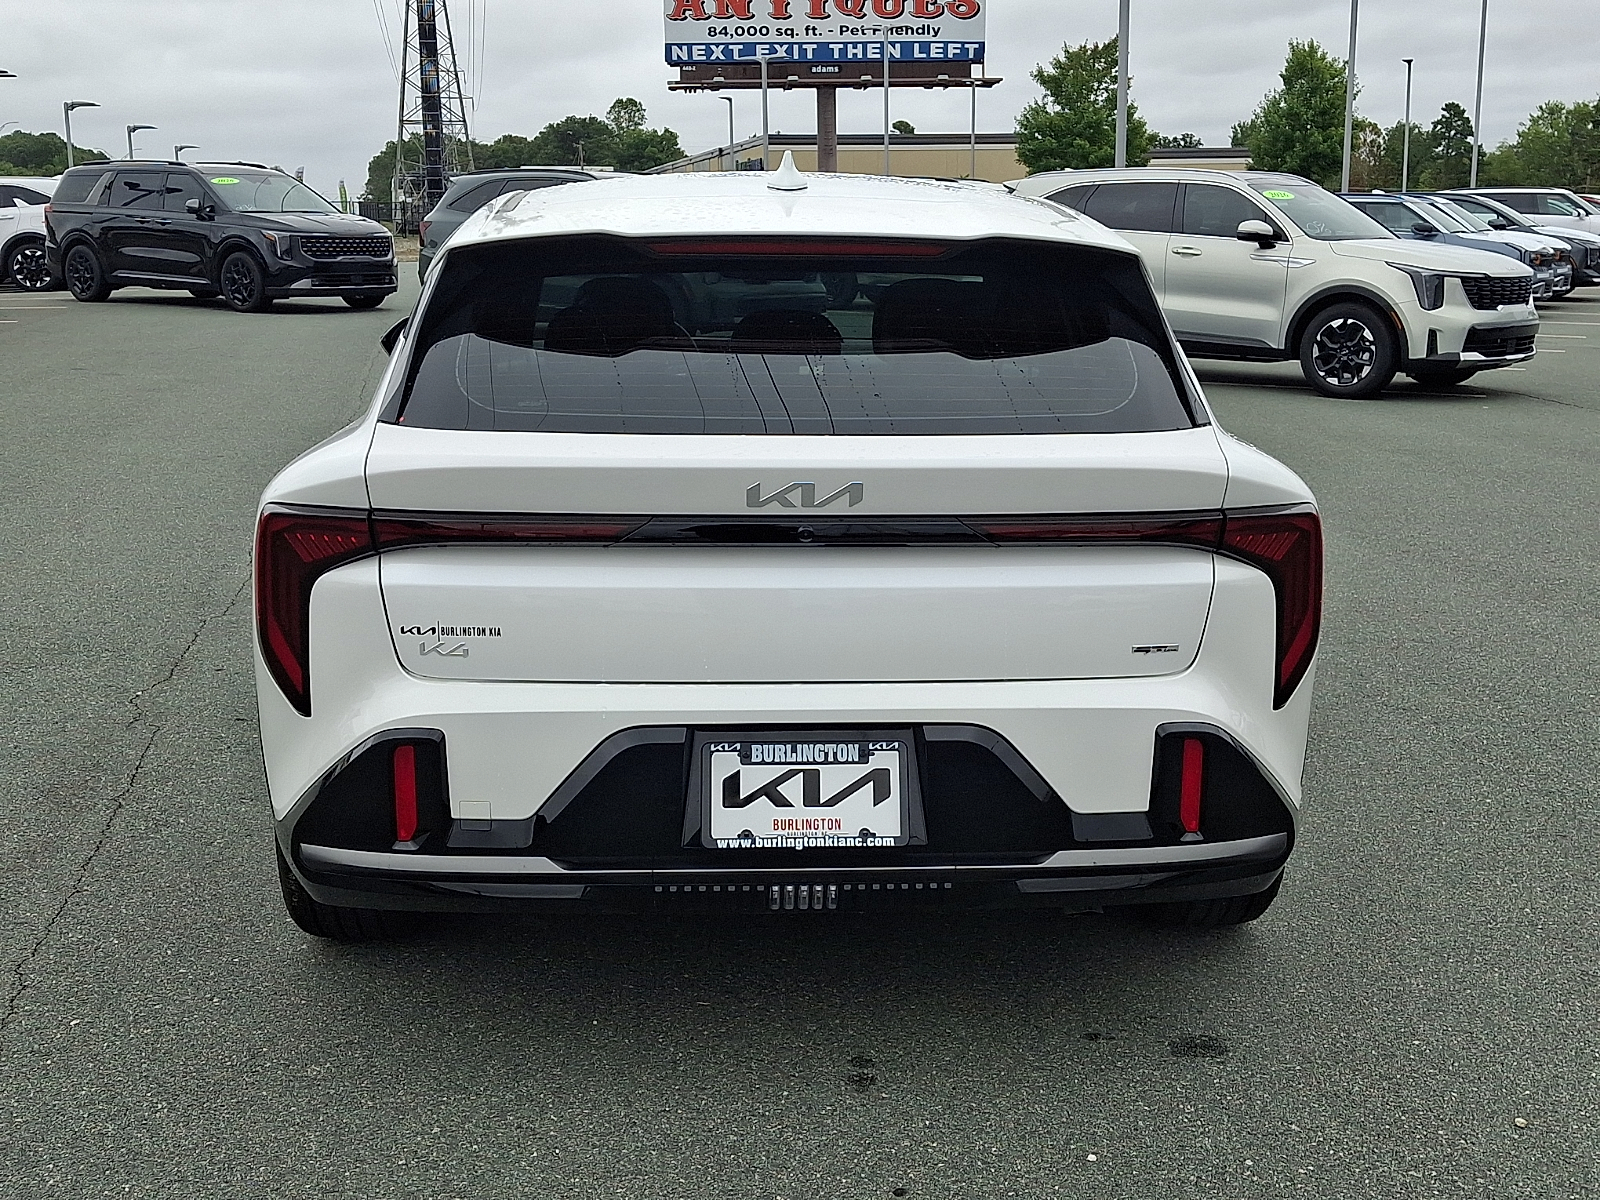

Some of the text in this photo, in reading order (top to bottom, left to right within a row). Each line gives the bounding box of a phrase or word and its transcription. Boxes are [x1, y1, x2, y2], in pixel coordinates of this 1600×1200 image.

[707, 25, 770, 39] 84,000
[775, 27, 799, 39] sq.
[804, 25, 823, 37] ft.
[839, 24, 864, 36] Pet
[872, 24, 941, 37] Fiendly
[671, 43, 979, 61] NEXT EXIT THEN LEFT
[811, 65, 839, 73] adams
[746, 481, 864, 508] KIA
[400, 625, 437, 636] KIA
[440, 626, 502, 638] BURLINGTON KIA
[419, 641, 469, 658] K4
[710, 743, 741, 751] KIA
[751, 744, 859, 762] BURLINGTON
[868, 742, 899, 750] KIA
[722, 768, 892, 808] KIA
[773, 818, 842, 831] BURLINGTON
[716, 836, 895, 850] www.burlingtonkianc.com
